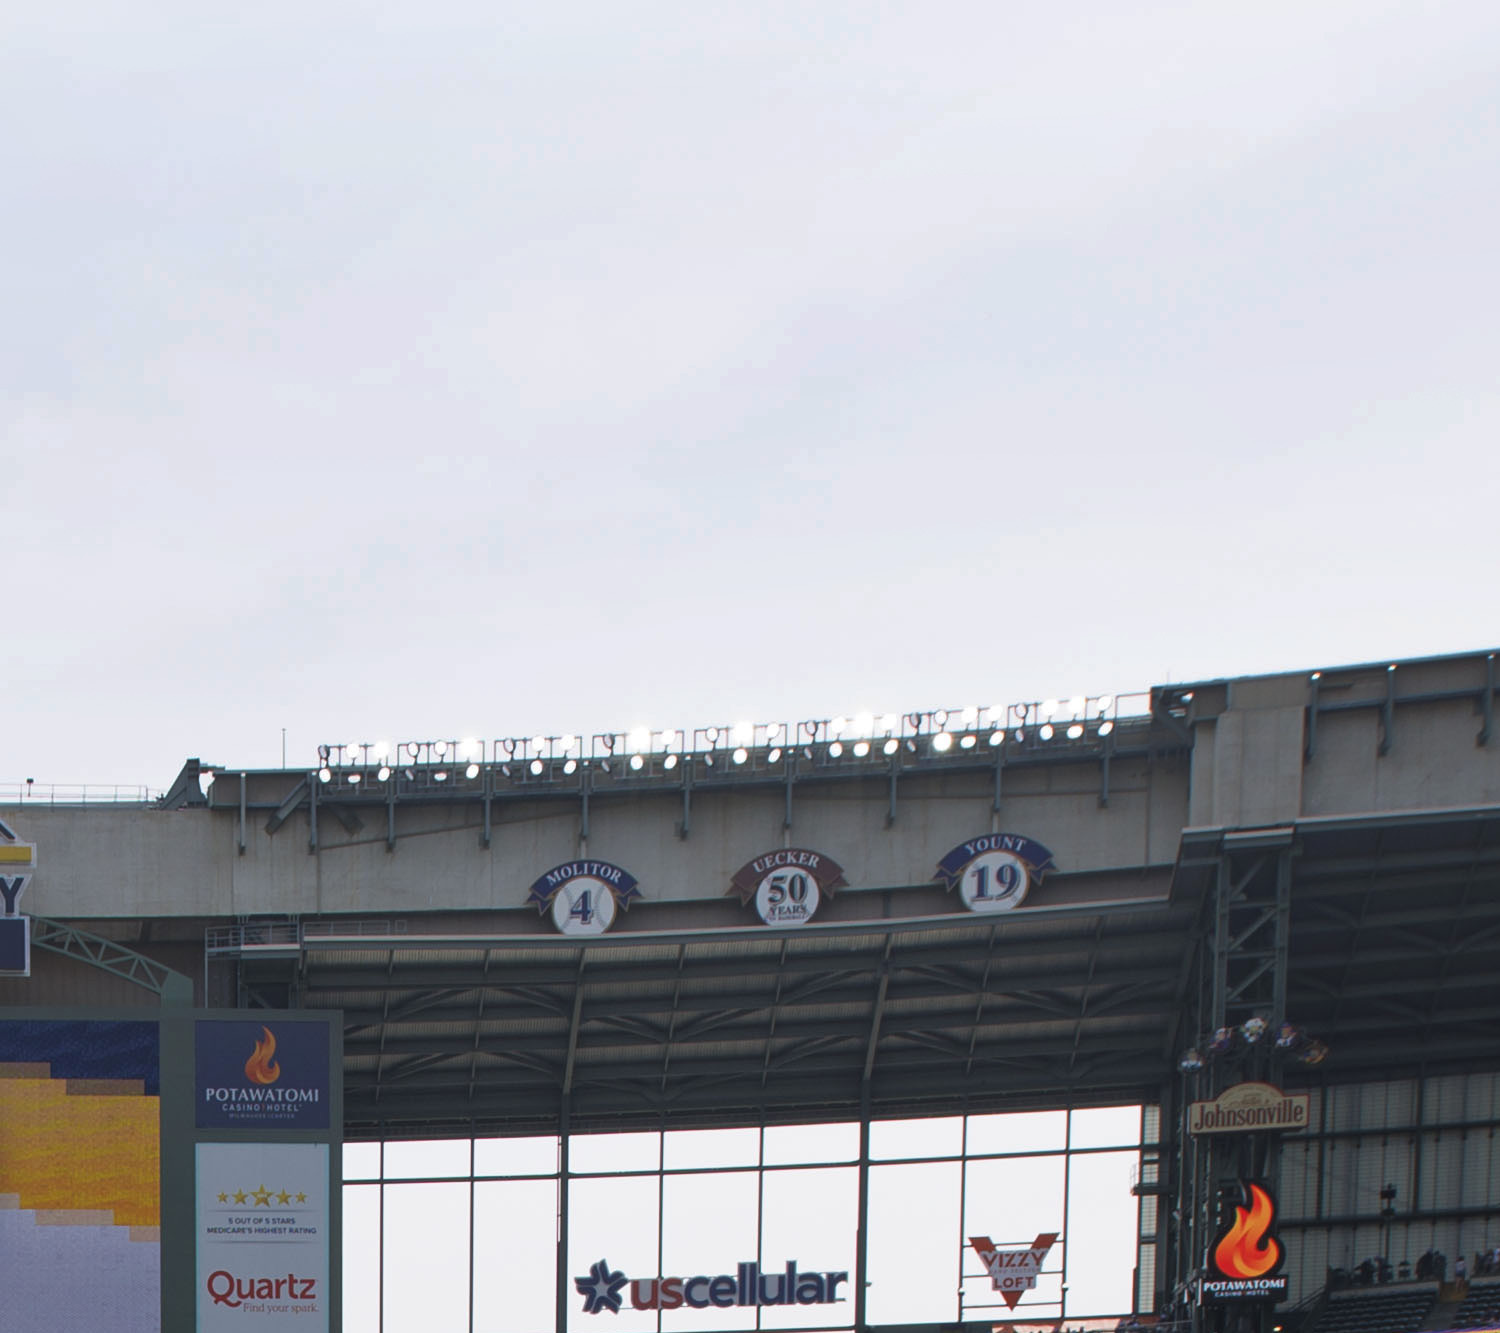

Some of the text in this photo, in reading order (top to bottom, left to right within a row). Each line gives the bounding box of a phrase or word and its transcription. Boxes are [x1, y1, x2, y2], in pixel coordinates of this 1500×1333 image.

[965, 835, 1027, 856] YOUNT
[752, 850, 820, 875] UECKER
[545, 863, 624, 888] MOLITOR
[971, 863, 1022, 901] 19
[766, 873, 809, 906] 50
[568, 888, 595, 927] 4
[205, 1087, 319, 1103] POTAWATOMI
[1193, 1100, 1305, 1131] Johnsonville
[981, 1251, 1046, 1269] VIZZY
[206, 1270, 317, 1308] Quartz
[994, 1275, 1035, 1290] LOFT
[1203, 1278, 1286, 1292] POTAWATOMI
